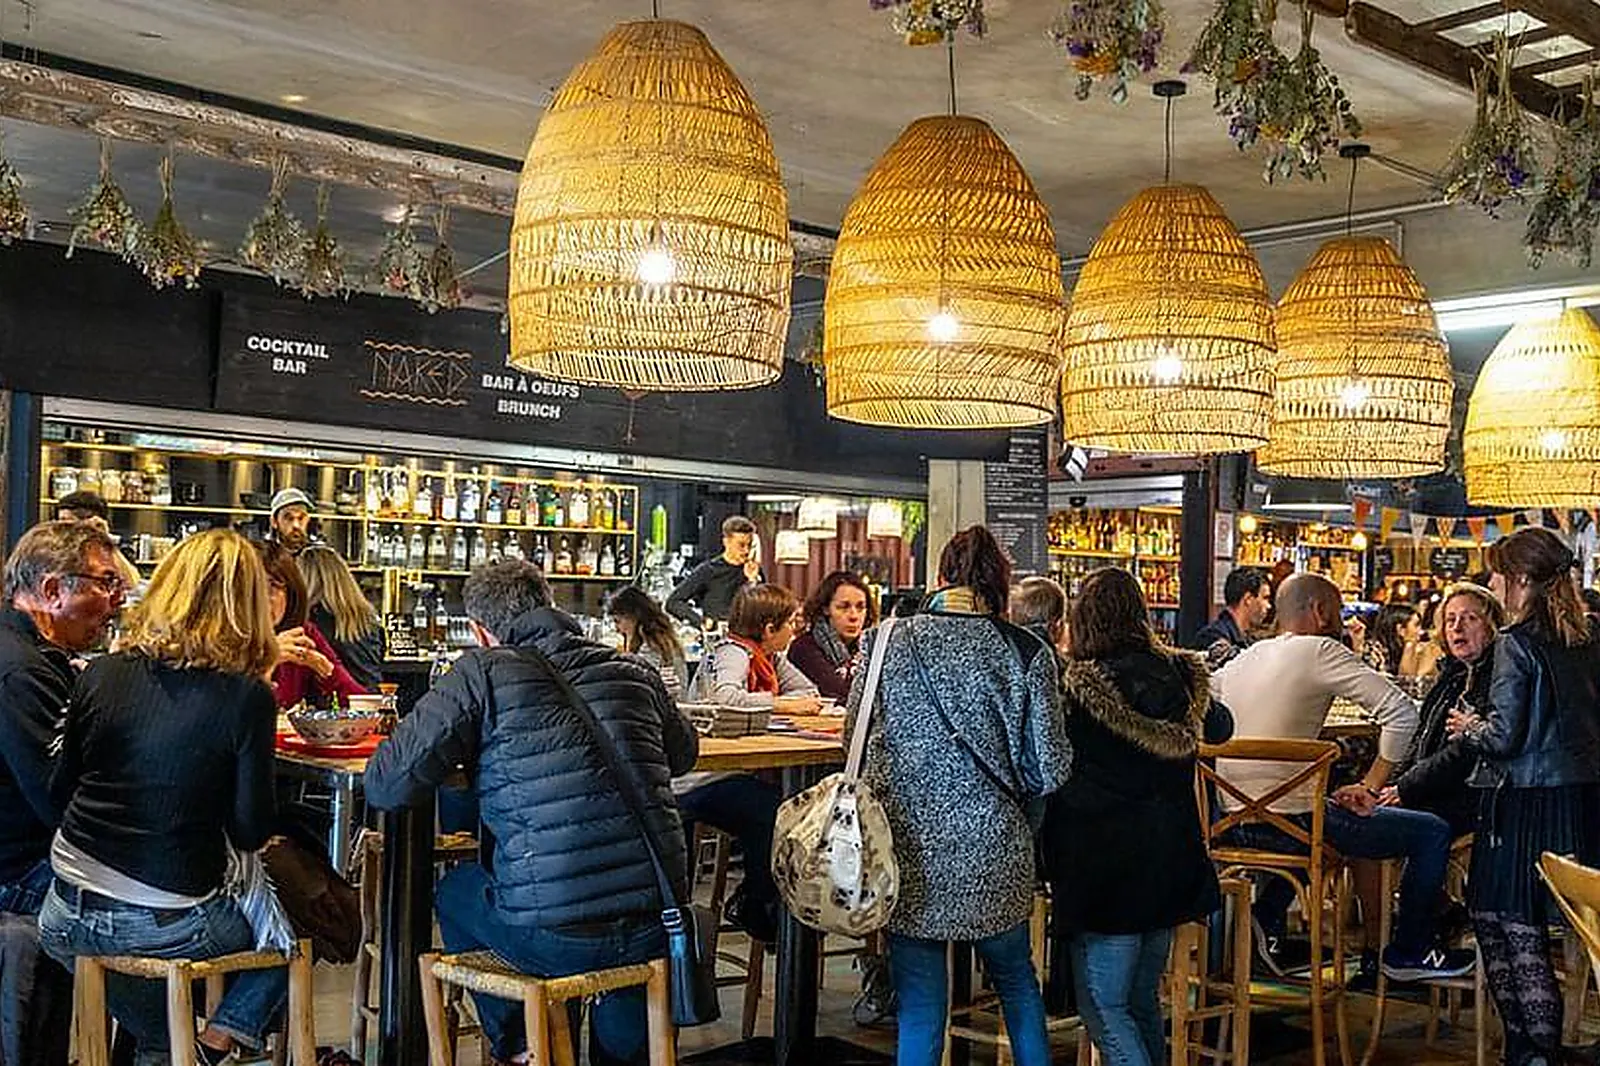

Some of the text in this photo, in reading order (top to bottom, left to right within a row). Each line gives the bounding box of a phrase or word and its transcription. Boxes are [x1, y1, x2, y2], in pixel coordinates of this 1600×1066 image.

[247, 336, 329, 358] COCKTAIL
[273, 357, 306, 374] BAR
[372, 352, 468, 396] NAKED
[482, 374, 514, 391] BAR
[531, 380, 580, 398] OEUFS
[497, 399, 561, 419] BRUNCH
[1422, 949, 1446, 968] N
